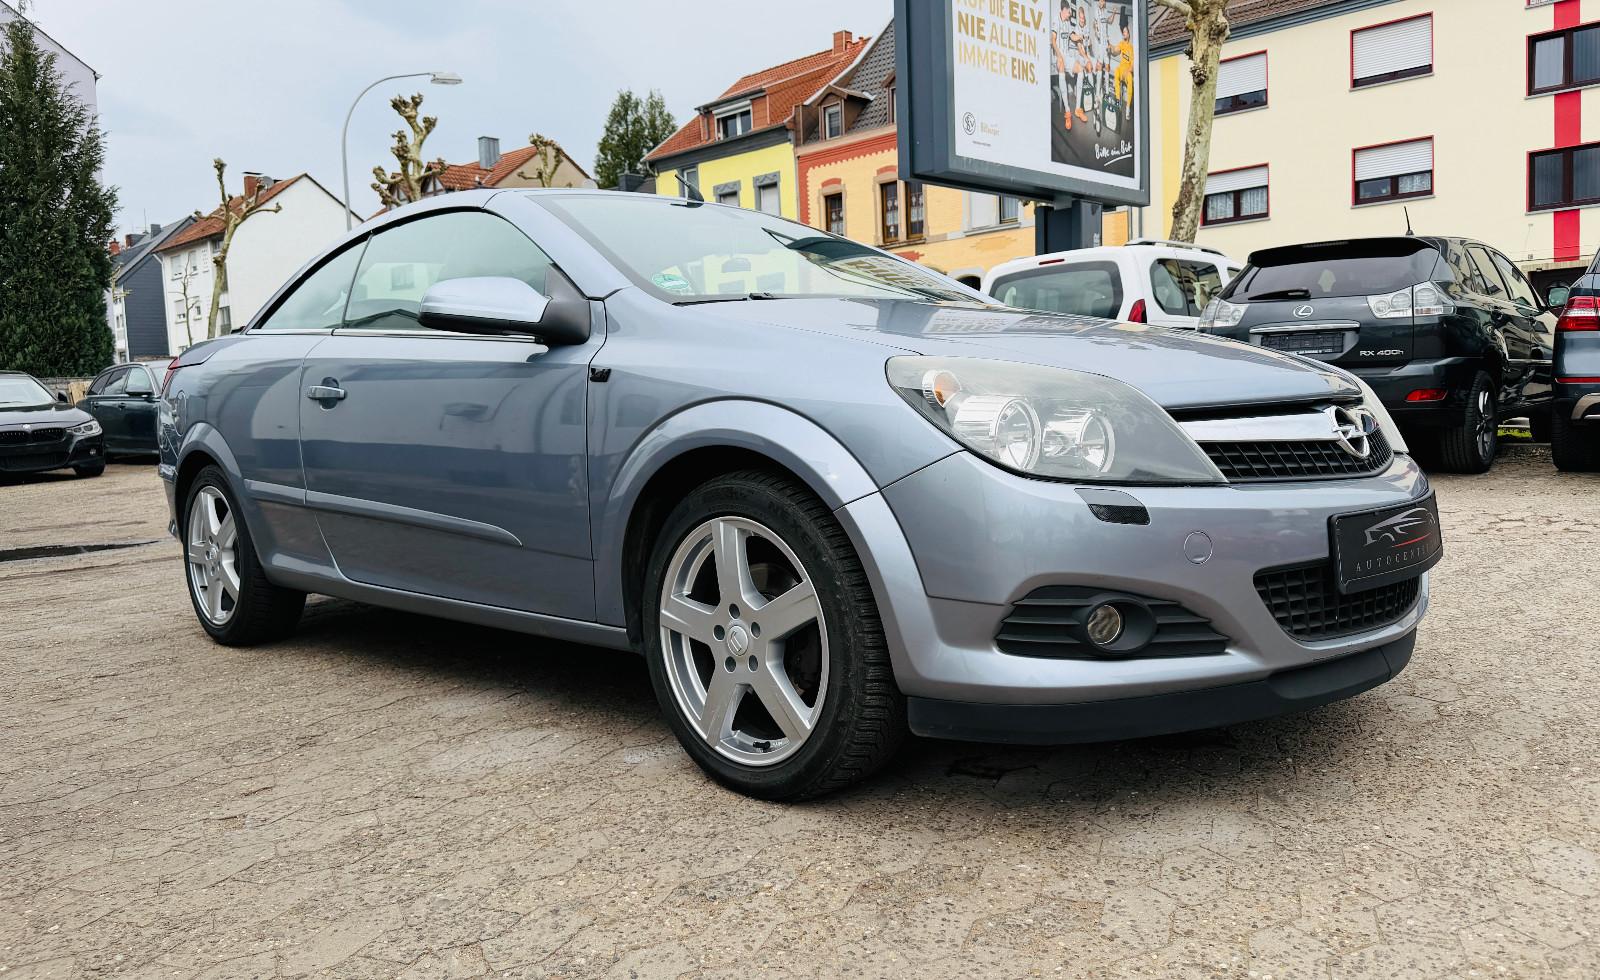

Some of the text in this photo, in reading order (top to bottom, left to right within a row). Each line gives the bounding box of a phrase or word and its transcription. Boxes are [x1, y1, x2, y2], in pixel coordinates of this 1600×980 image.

[957, 10, 986, 41] NIE
[1009, 0, 1046, 33] ELV.
[958, 40, 1039, 86] IMMER EINS.
[1120, 139, 1133, 154] Bit
